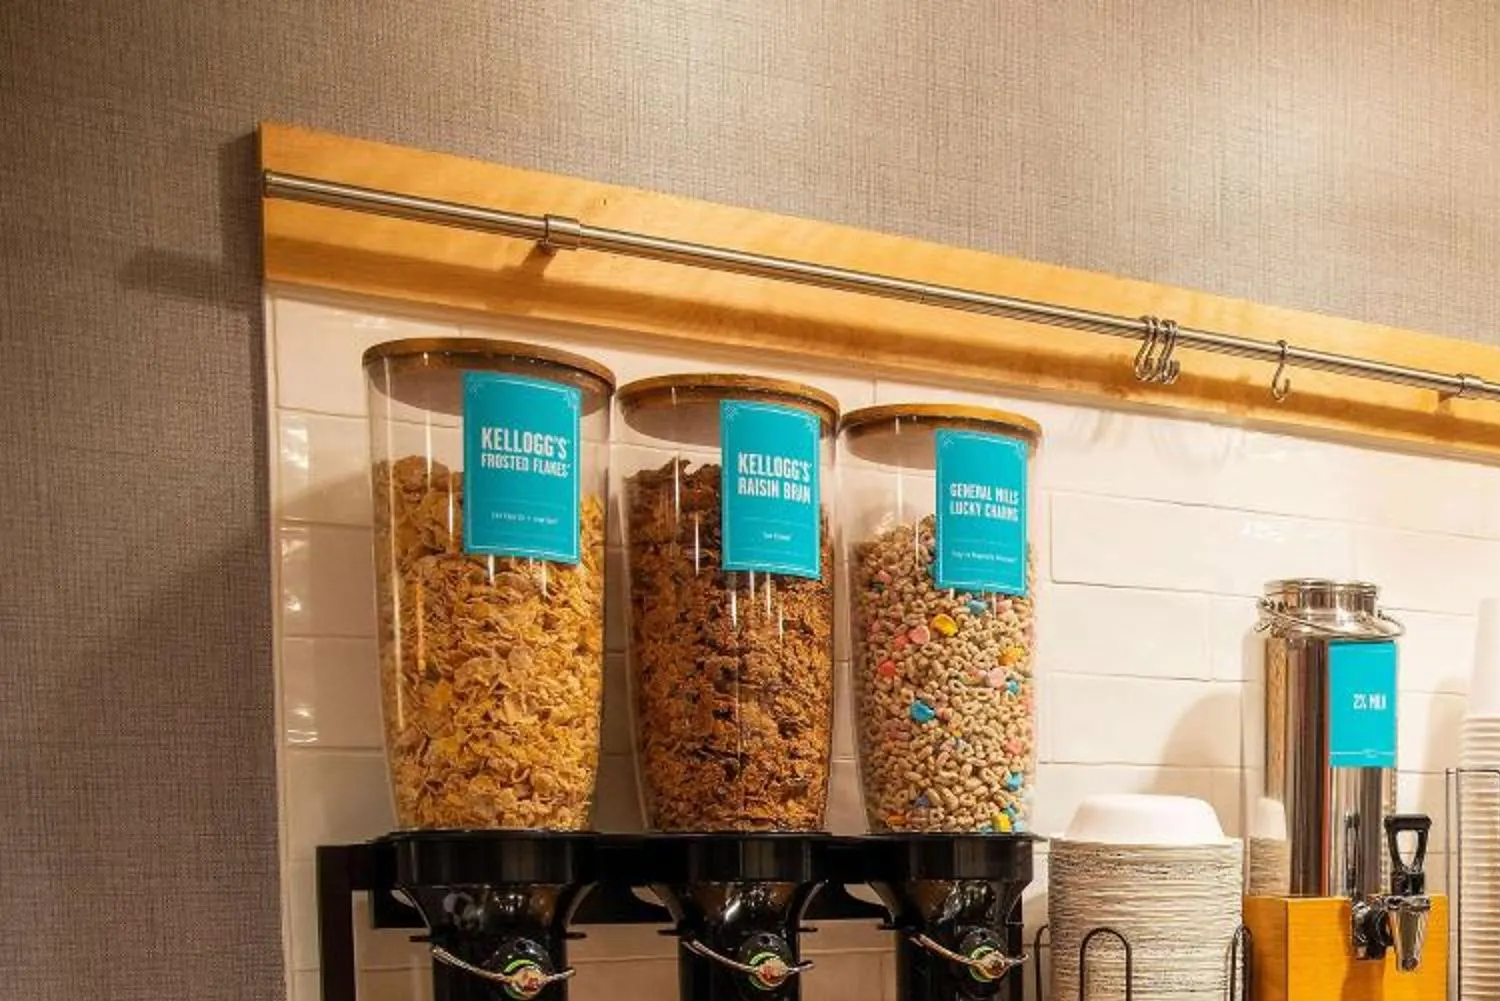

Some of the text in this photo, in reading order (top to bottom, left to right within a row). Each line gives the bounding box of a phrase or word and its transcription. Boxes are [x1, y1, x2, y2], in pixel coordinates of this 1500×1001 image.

[481, 427, 567, 460] KELLOGG'S
[481, 453, 569, 478] FROSTED FLAKES
[737, 452, 811, 482] KELLOGG'S
[738, 477, 811, 504] RAISIN BRAN
[950, 483, 1019, 505] GENERAL MILLS
[950, 501, 981, 517] LUCKY
